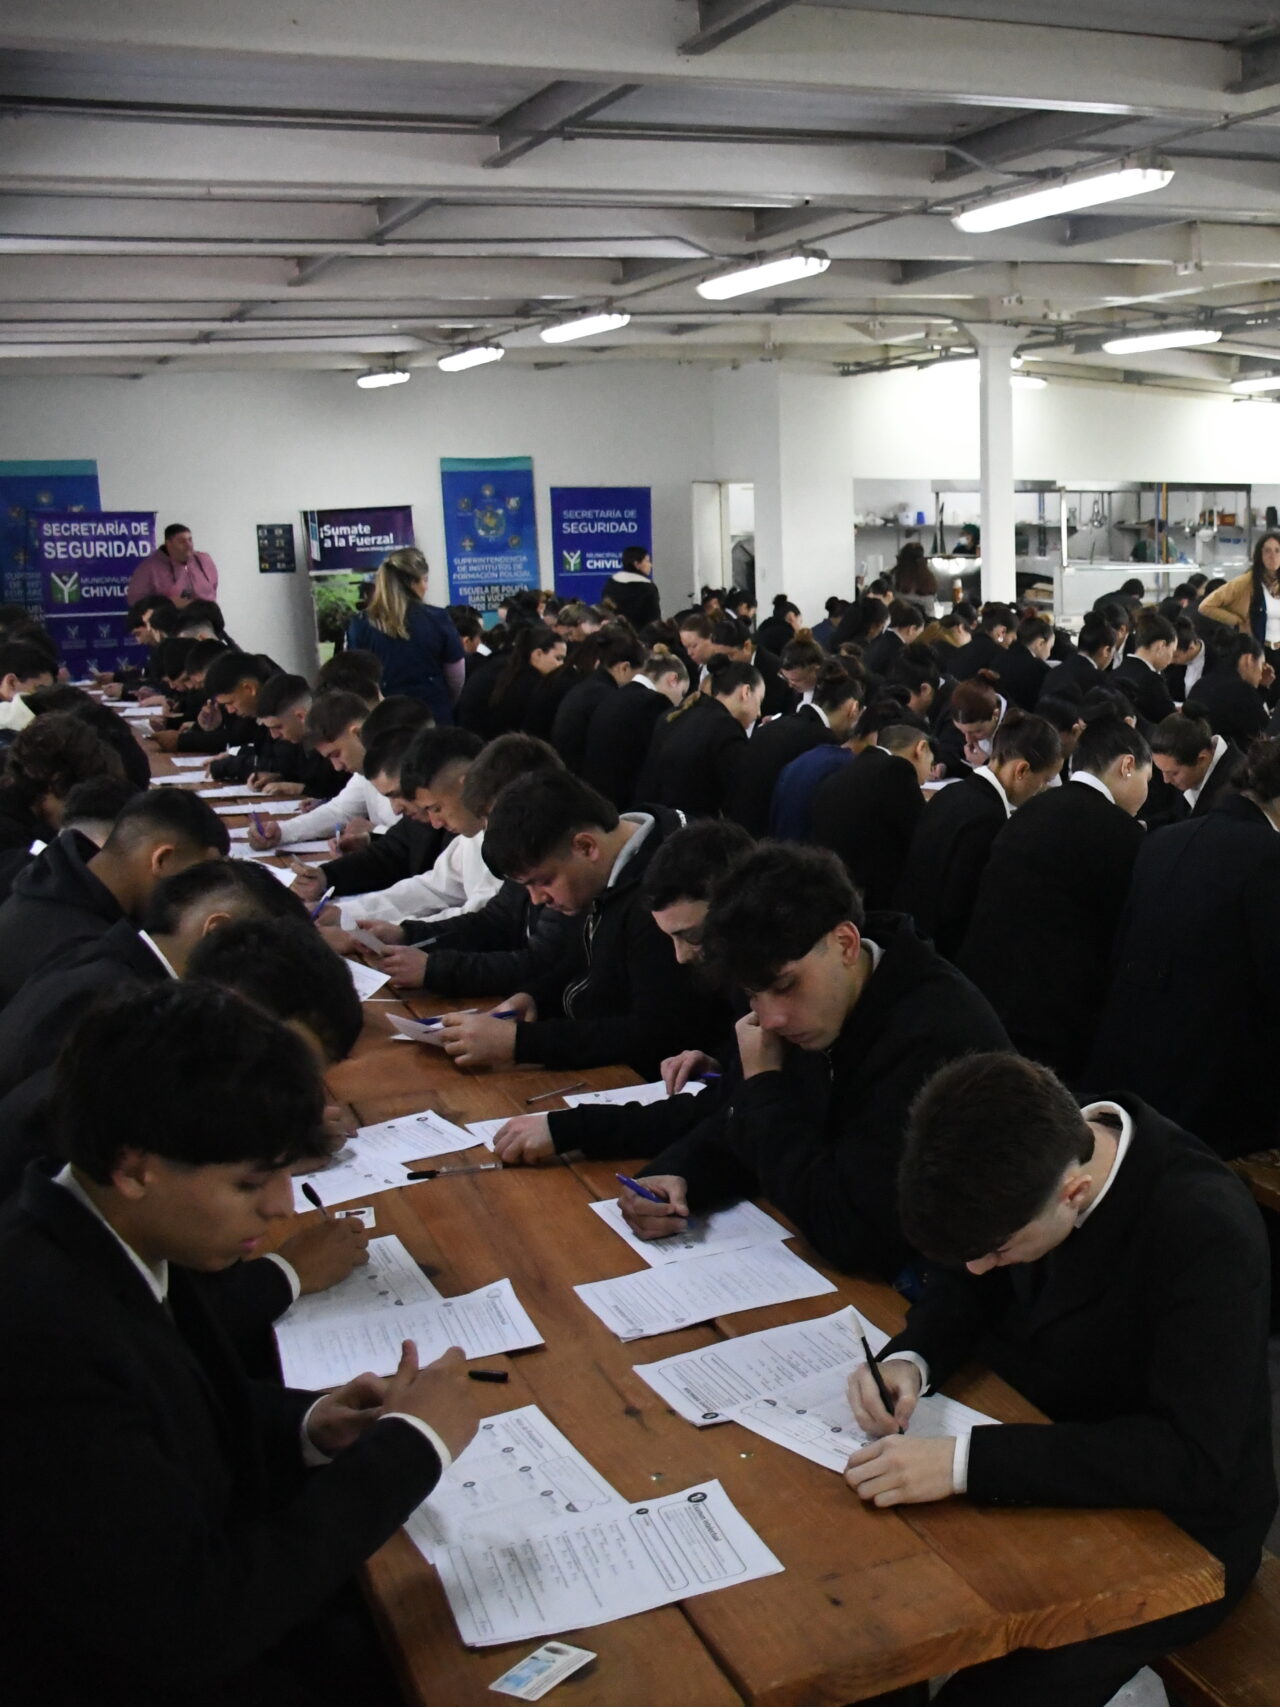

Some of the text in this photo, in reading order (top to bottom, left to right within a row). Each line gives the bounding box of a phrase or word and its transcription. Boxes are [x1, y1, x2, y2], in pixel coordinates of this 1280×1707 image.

[563, 508, 637, 519] SECRETARÍA DE
[43, 520, 149, 536] SECRETARÍA DE
[320, 523, 371, 539] ¡Sumate
[562, 521, 638, 534] SEGURIDAD
[323, 532, 394, 548] a la Fuerza!
[43, 540, 151, 559] SEGURIDAD
[586, 559, 624, 570] CHIVIL
